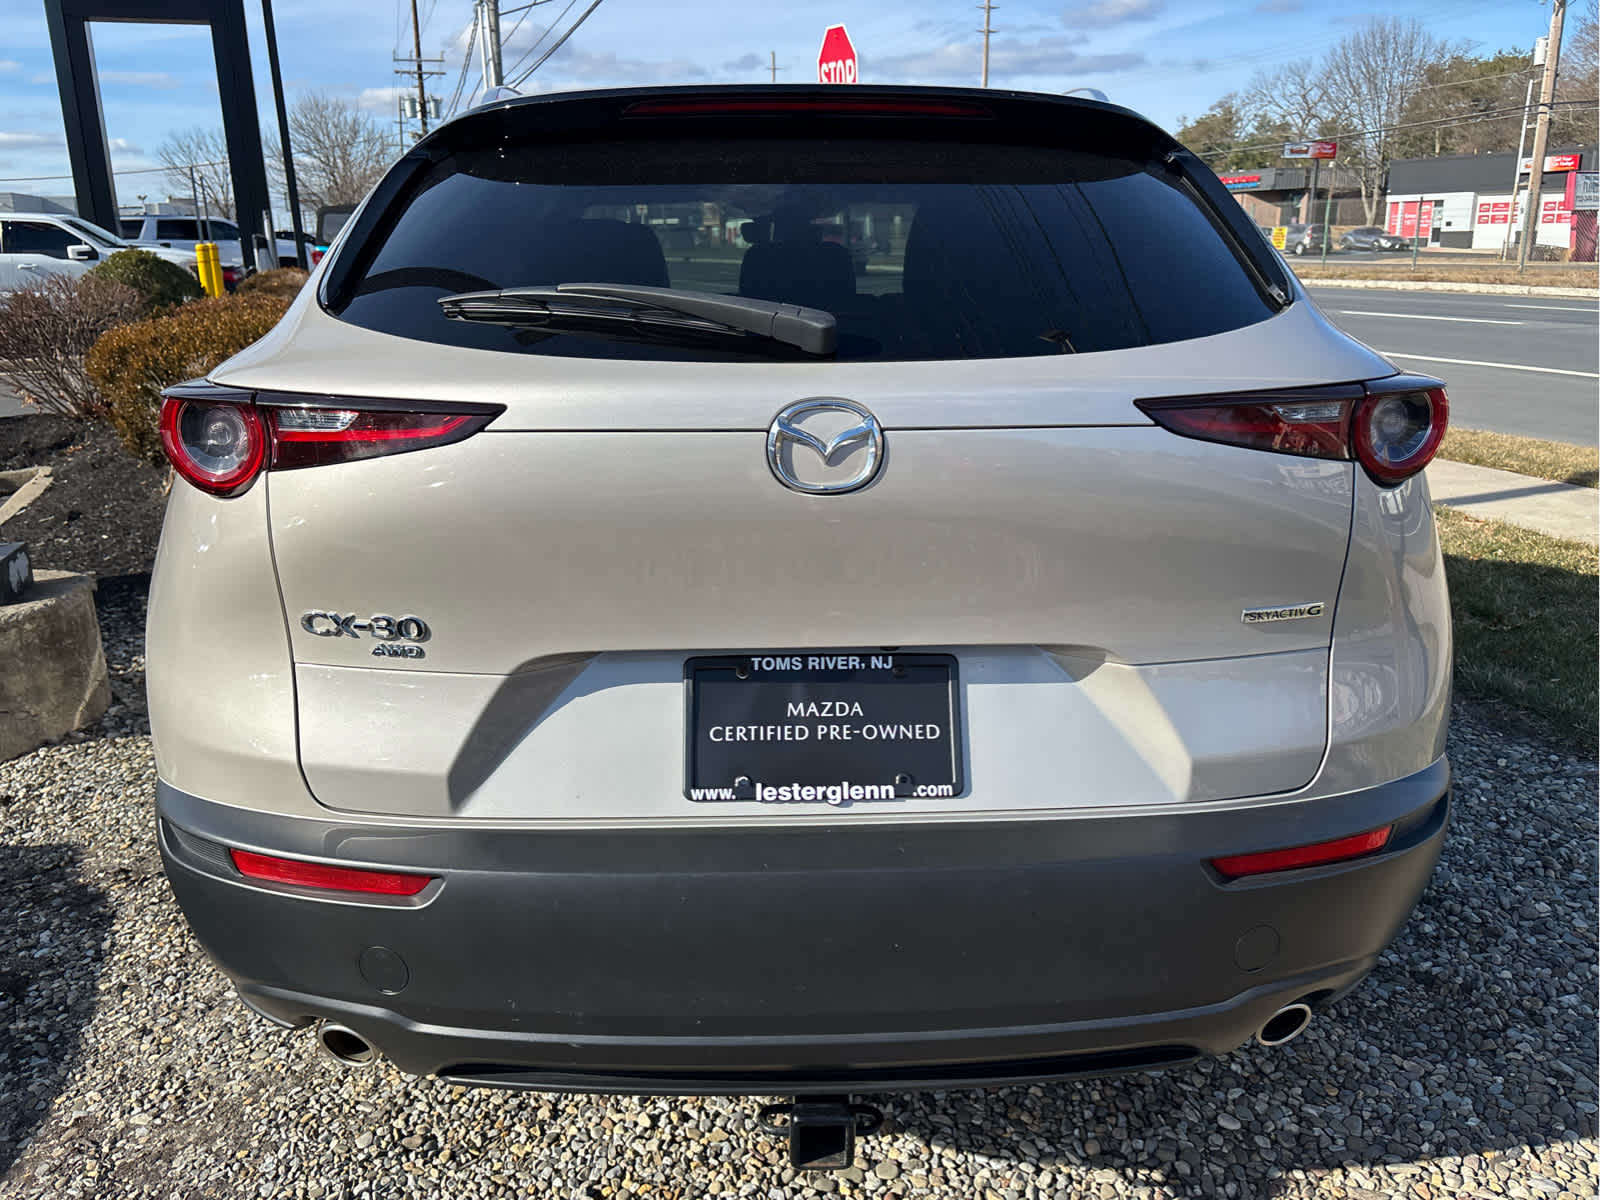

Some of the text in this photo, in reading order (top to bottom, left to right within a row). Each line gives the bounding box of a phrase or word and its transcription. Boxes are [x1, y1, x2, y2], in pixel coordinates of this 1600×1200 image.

[821, 59, 856, 84] STOP
[301, 610, 432, 643] CX-30
[371, 643, 426, 659] AWD
[751, 655, 893, 671] TOMS RIVER, NJ
[787, 701, 864, 717] MAZDA
[709, 724, 940, 742] CERTIFIED PRE-OWNED
[690, 781, 953, 805] www. lesterglenn .com
